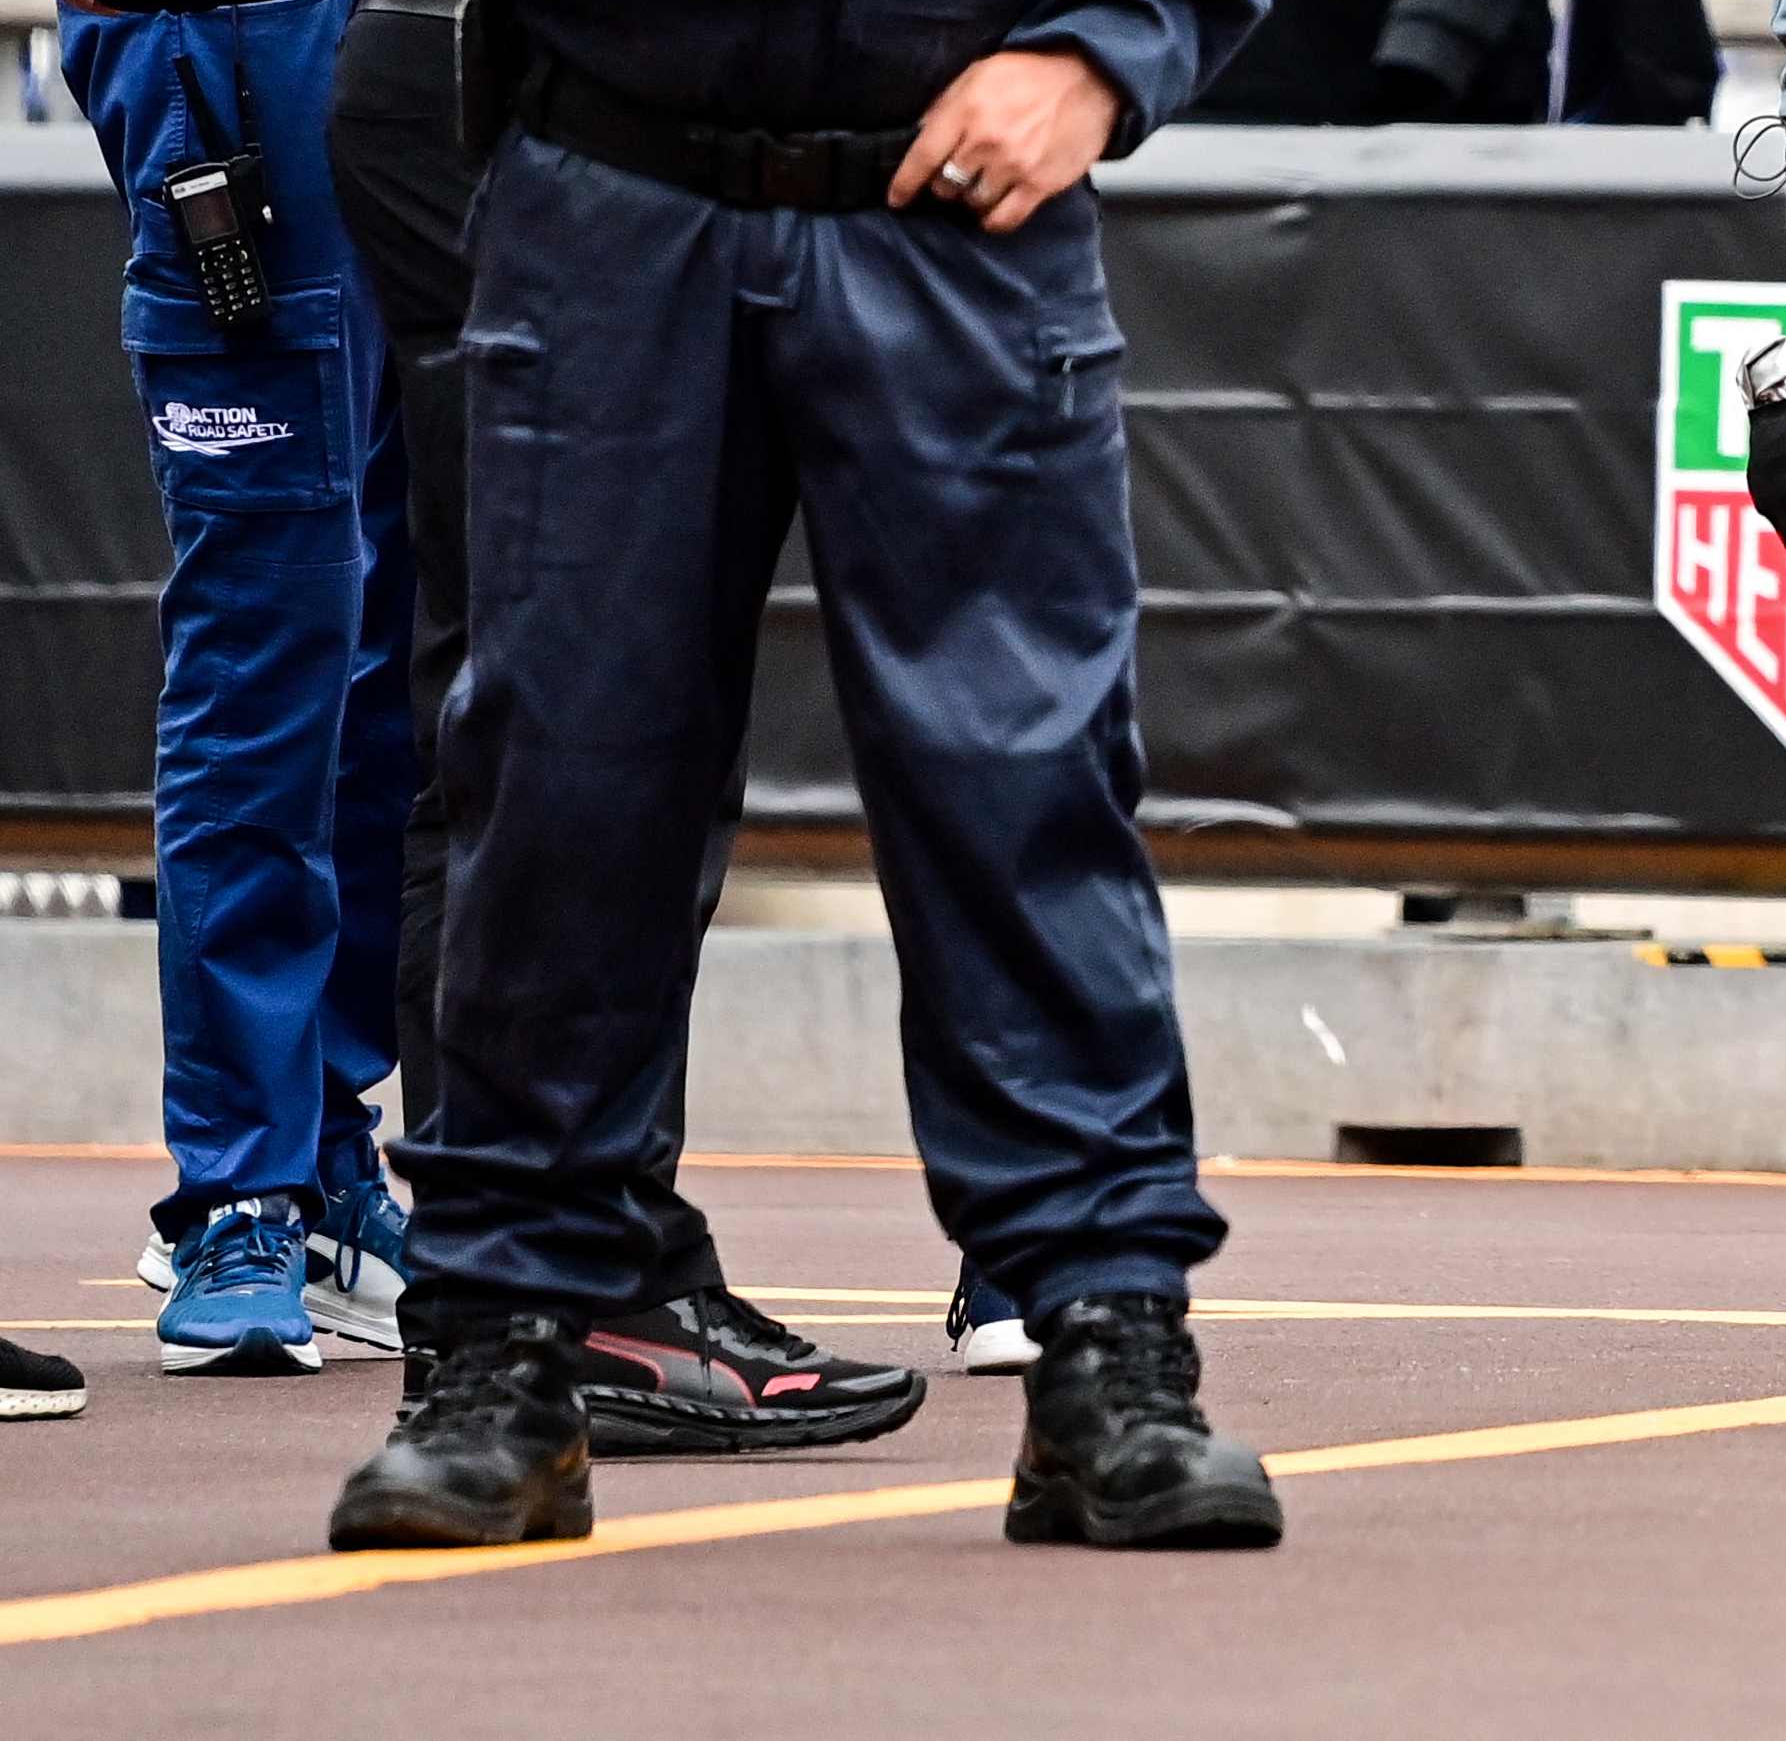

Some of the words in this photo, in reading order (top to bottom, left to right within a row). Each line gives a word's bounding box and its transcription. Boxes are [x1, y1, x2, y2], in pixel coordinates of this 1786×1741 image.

[191, 407, 257, 424] ACTION
[188, 424, 226, 438] ROAD
[227, 422, 288, 438] SAFETY
